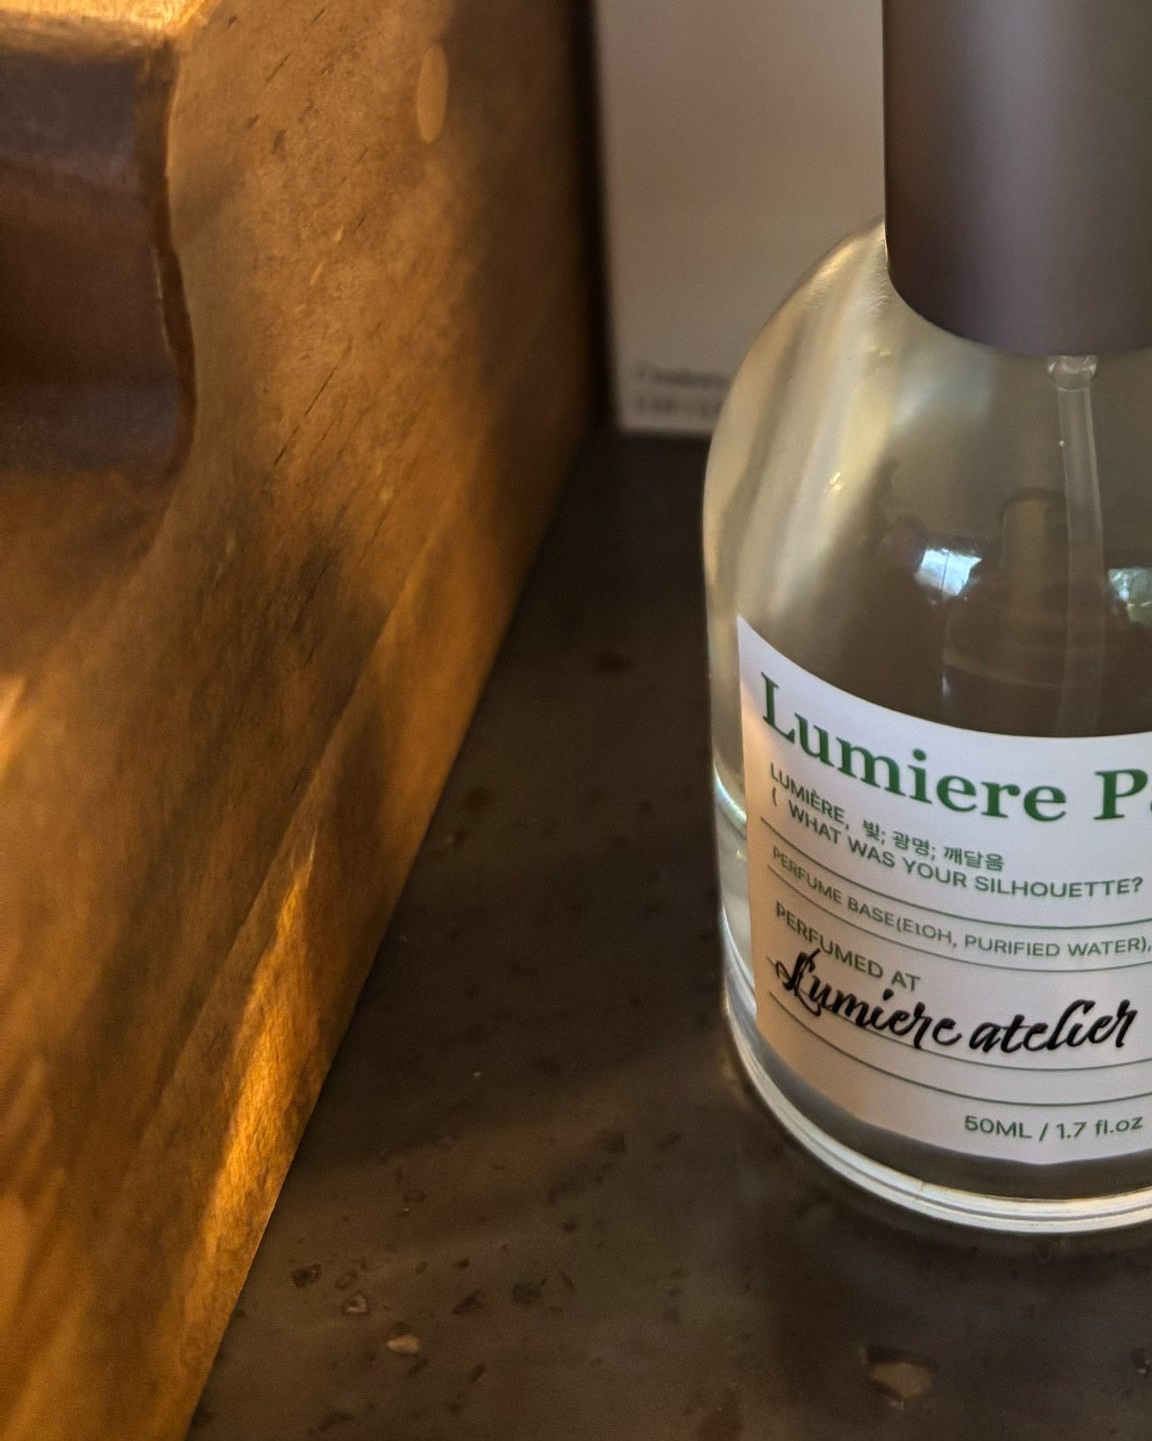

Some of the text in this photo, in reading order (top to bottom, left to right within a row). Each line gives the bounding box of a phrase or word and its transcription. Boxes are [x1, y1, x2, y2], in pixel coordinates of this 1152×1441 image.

[761, 671, 1067, 822] Lumiere
[770, 762, 849, 831] LUMIÈRE,
[892, 830, 937, 861] 광명;
[943, 845, 1005, 873] 깨달음
[788, 799, 842, 845] WHAT
[847, 835, 896, 869] WAS
[902, 856, 968, 889] YOUR
[974, 875, 1144, 898] SILHOUETTE?
[773, 844, 843, 905] PERFUME
[847, 895, 958, 948] BASE(EtOH,
[964, 933, 1061, 957] PURIFIED
[1067, 935, 1152, 957] WATER),
[775, 899, 921, 992] PERFUMED AT
[774, 947, 1139, 1054] Lumiere atelier
[964, 1114, 1144, 1143] 50ML / 1.7 fl.oz
